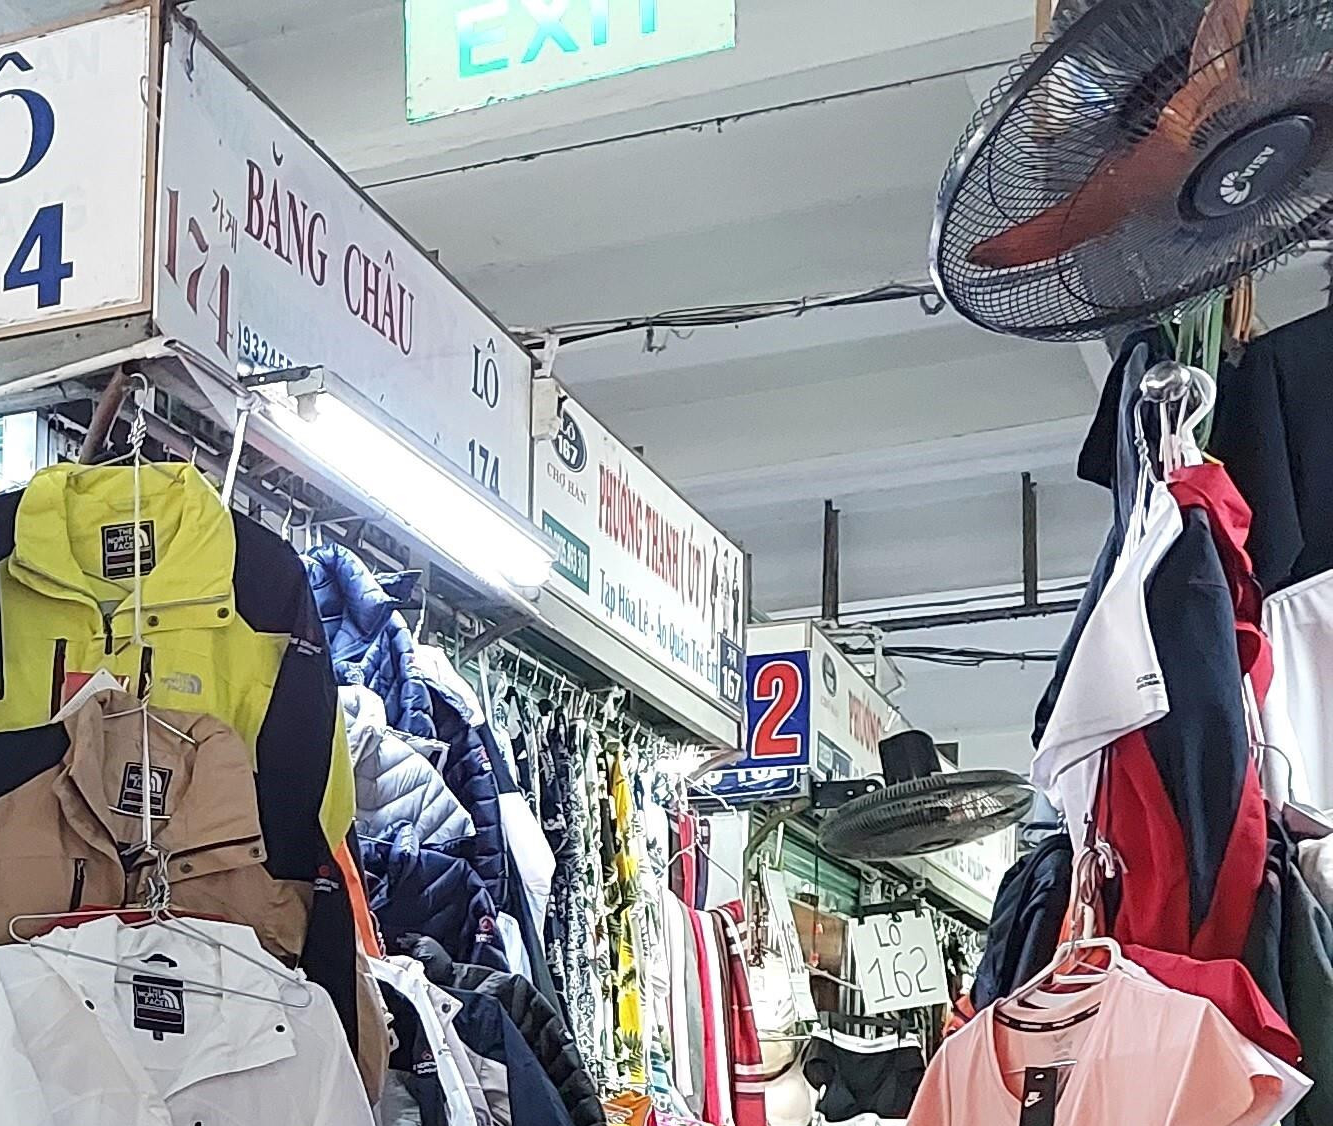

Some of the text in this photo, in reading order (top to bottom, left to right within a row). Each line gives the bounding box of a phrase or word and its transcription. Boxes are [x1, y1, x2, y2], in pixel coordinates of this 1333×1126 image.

[246, 142, 415, 356] BĂNG CHÂU
[471, 338, 499, 409] LÔ
[117, 528, 134, 536] THE
[721, 666, 742, 704] 167
[751, 660, 803, 760] 2
[867, 946, 937, 1003] 162
